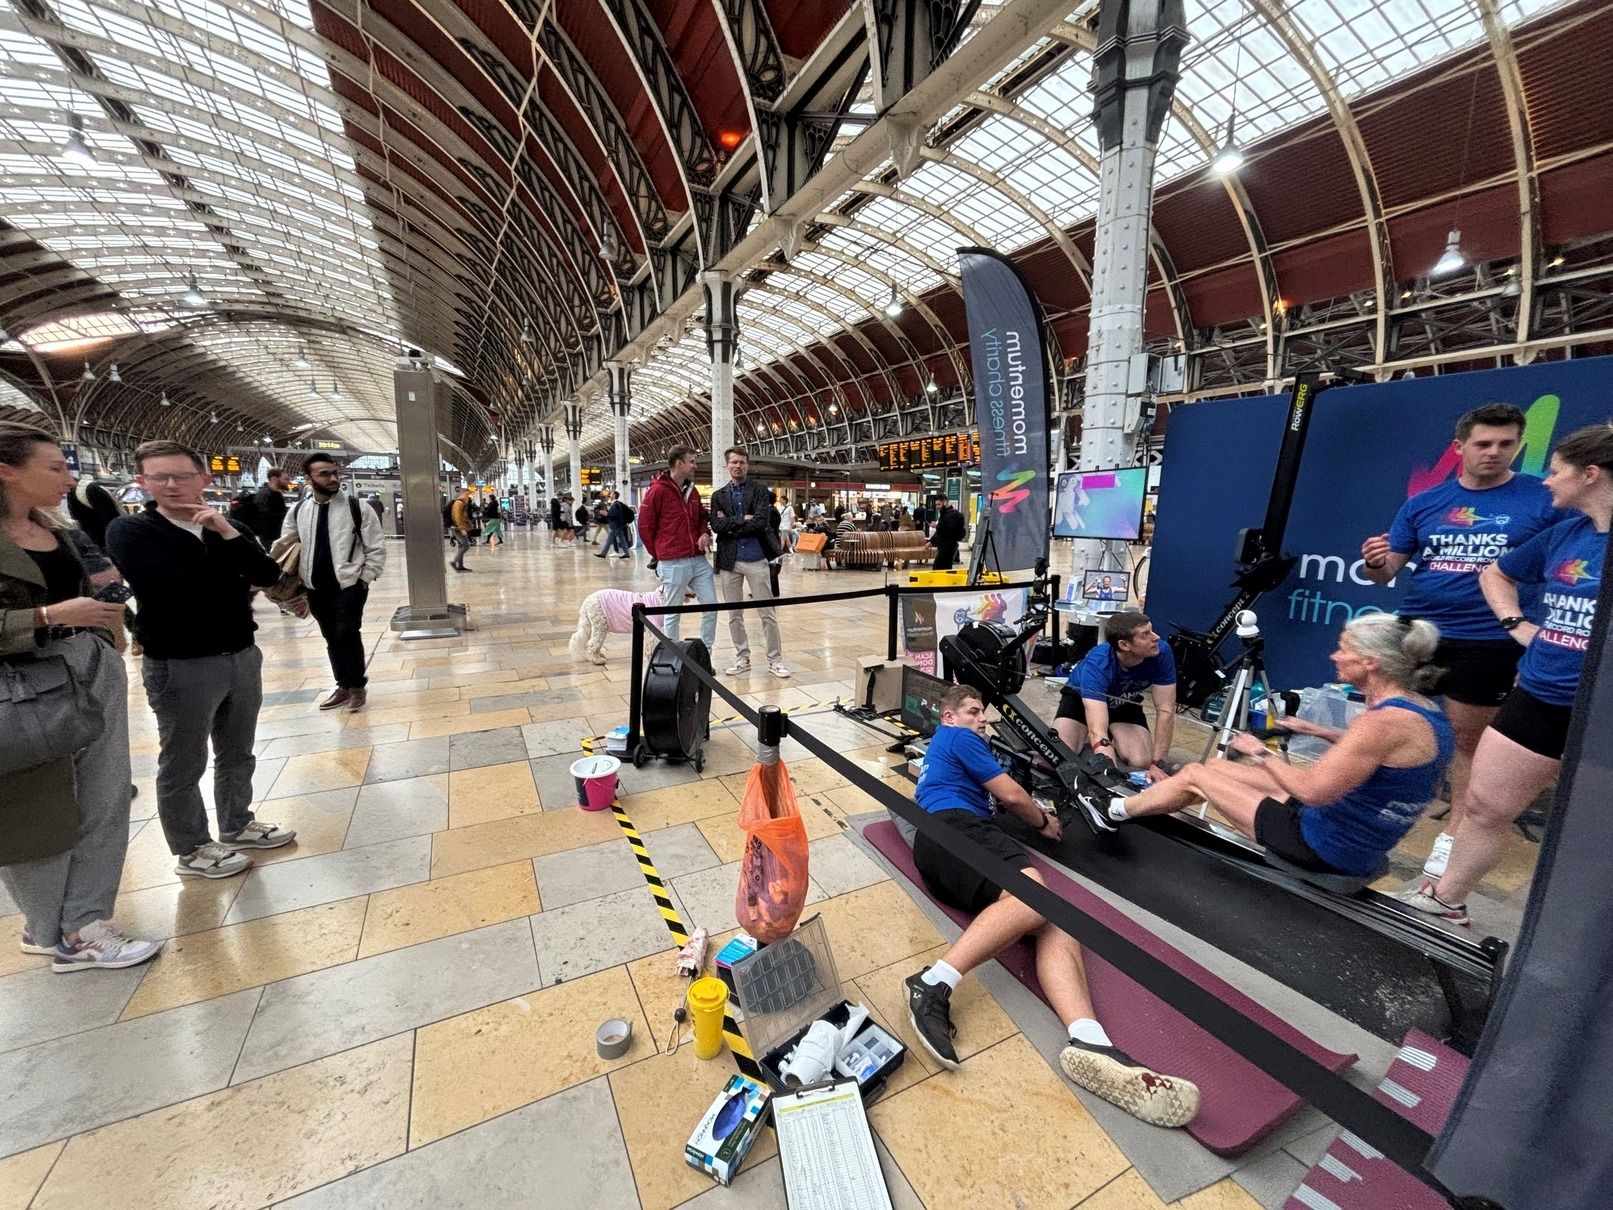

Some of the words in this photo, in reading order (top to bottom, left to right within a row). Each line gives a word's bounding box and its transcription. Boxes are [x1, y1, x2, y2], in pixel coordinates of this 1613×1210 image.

[1422, 546, 1436, 557] A
[1429, 533, 1508, 546] THANKS
[1216, 598, 1246, 634] concept
[1014, 717, 1060, 766] concept
